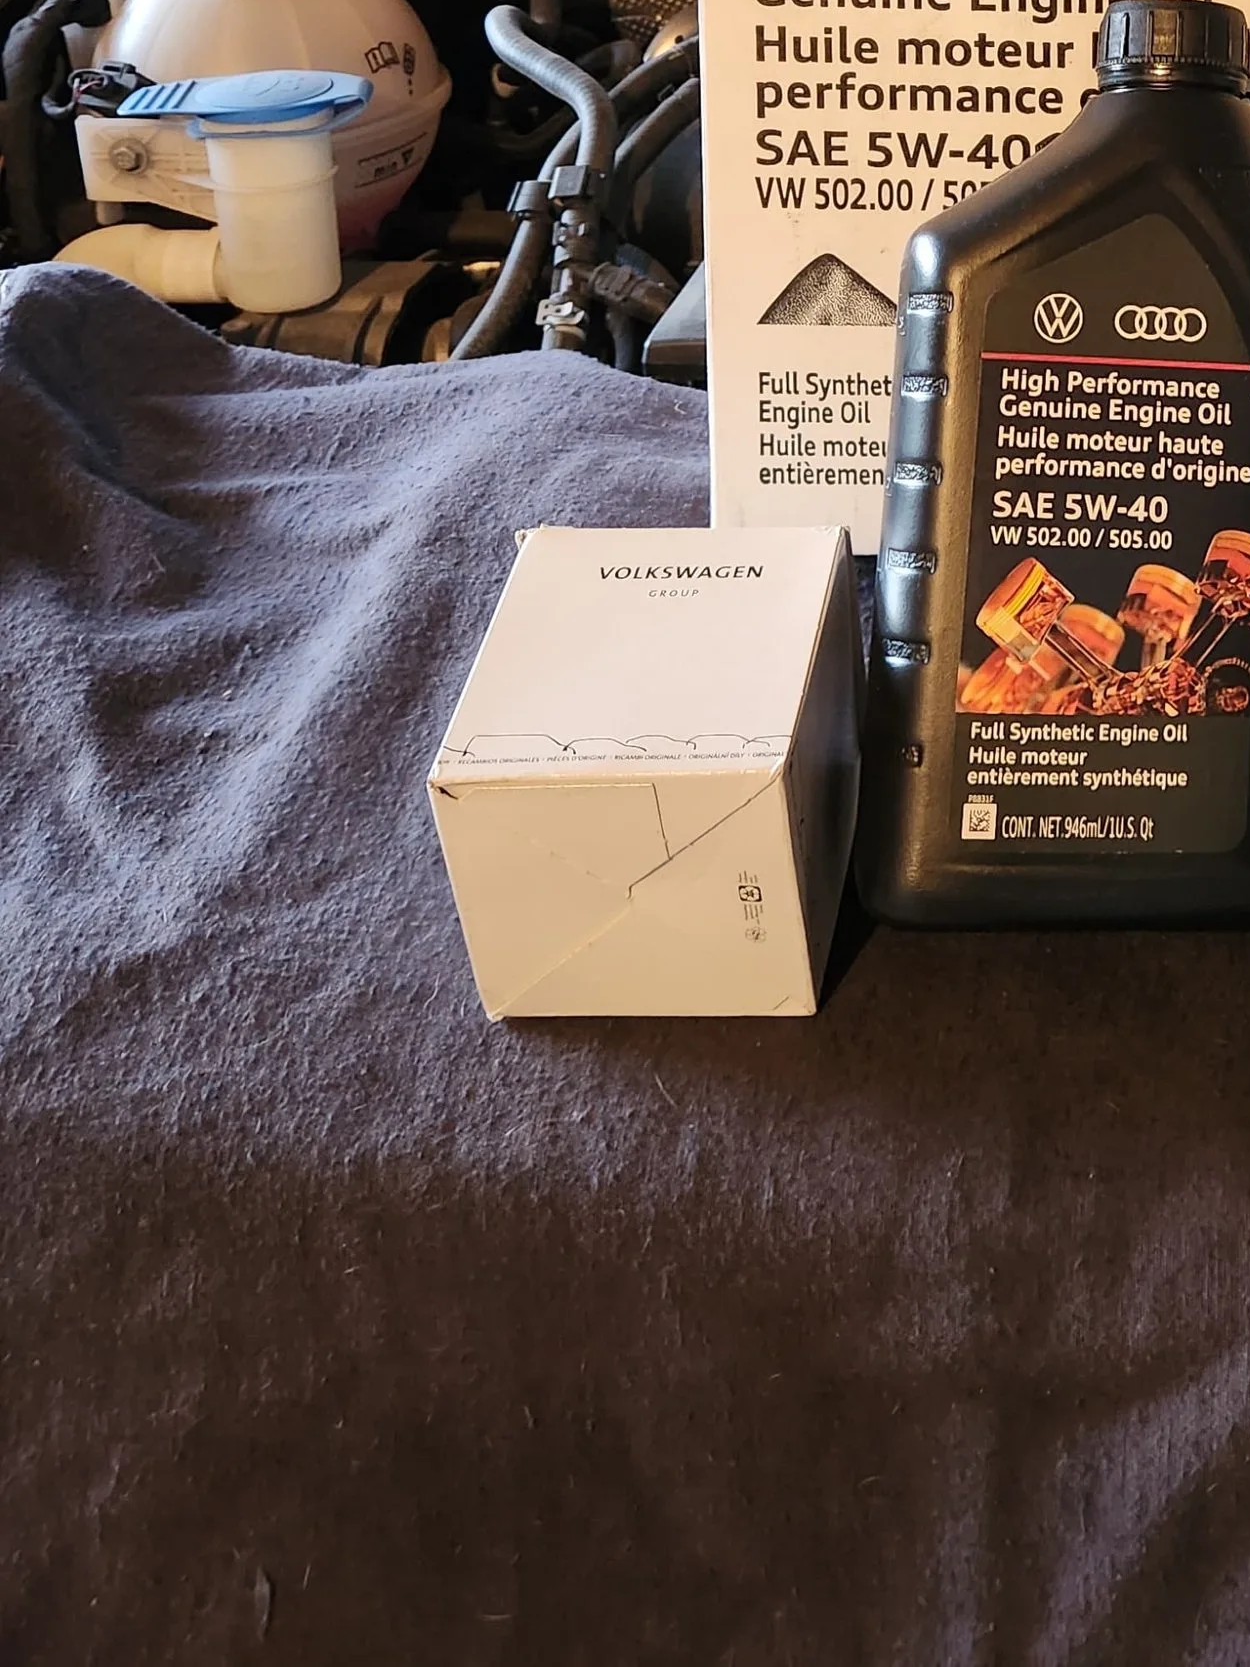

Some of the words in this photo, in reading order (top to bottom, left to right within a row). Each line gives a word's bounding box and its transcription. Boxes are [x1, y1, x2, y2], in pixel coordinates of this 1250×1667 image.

[755, 24, 880, 65] Huile
[897, 32, 1075, 70] moteur
[755, 70, 1064, 119] performance
[755, 128, 850, 167] SAE
[866, 130, 1032, 170] 5W-40
[754, 176, 806, 209] VW
[813, 177, 914, 211] 502.00
[920, 178, 934, 211] /
[758, 371, 800, 396] Full
[805, 372, 893, 402] Synthet
[1000, 367, 1061, 398] High
[1066, 369, 1222, 400] Performance
[758, 399, 834, 430] Engine
[840, 401, 872, 424] Oil
[999, 393, 1102, 421] Genuine
[1107, 398, 1192, 428] Engine
[1197, 402, 1233, 426] Oil
[759, 433, 817, 457] Huile
[823, 436, 887, 458] mote
[997, 424, 1061, 450] Huile
[1065, 430, 1153, 453] moteur
[1158, 430, 1225, 456] haute
[759, 460, 885, 486] entièremen
[994, 452, 1147, 481] performance
[991, 489, 1056, 520] SAE
[1063, 492, 1170, 524] 5W-40
[989, 524, 1023, 546] VW
[1026, 525, 1092, 548] 502.00
[1095, 527, 1105, 548] /
[1108, 528, 1173, 551] 505.00
[599, 564, 765, 581] VOLKSWAGEN
[648, 588, 700, 599] GROUP
[970, 721, 1006, 741] Full
[1009, 721, 1095, 745] Synthetic
[1098, 723, 1160, 747] Engine
[1162, 723, 1189, 743] Oil
[968, 745, 1017, 765] Huile
[1020, 748, 1088, 766] moteur
[966, 766, 1080, 787] entièrement
[1082, 767, 1189, 791] synthétique
[1001, 815, 1036, 839] CONT.
[1139, 815, 1155, 841] Qt
